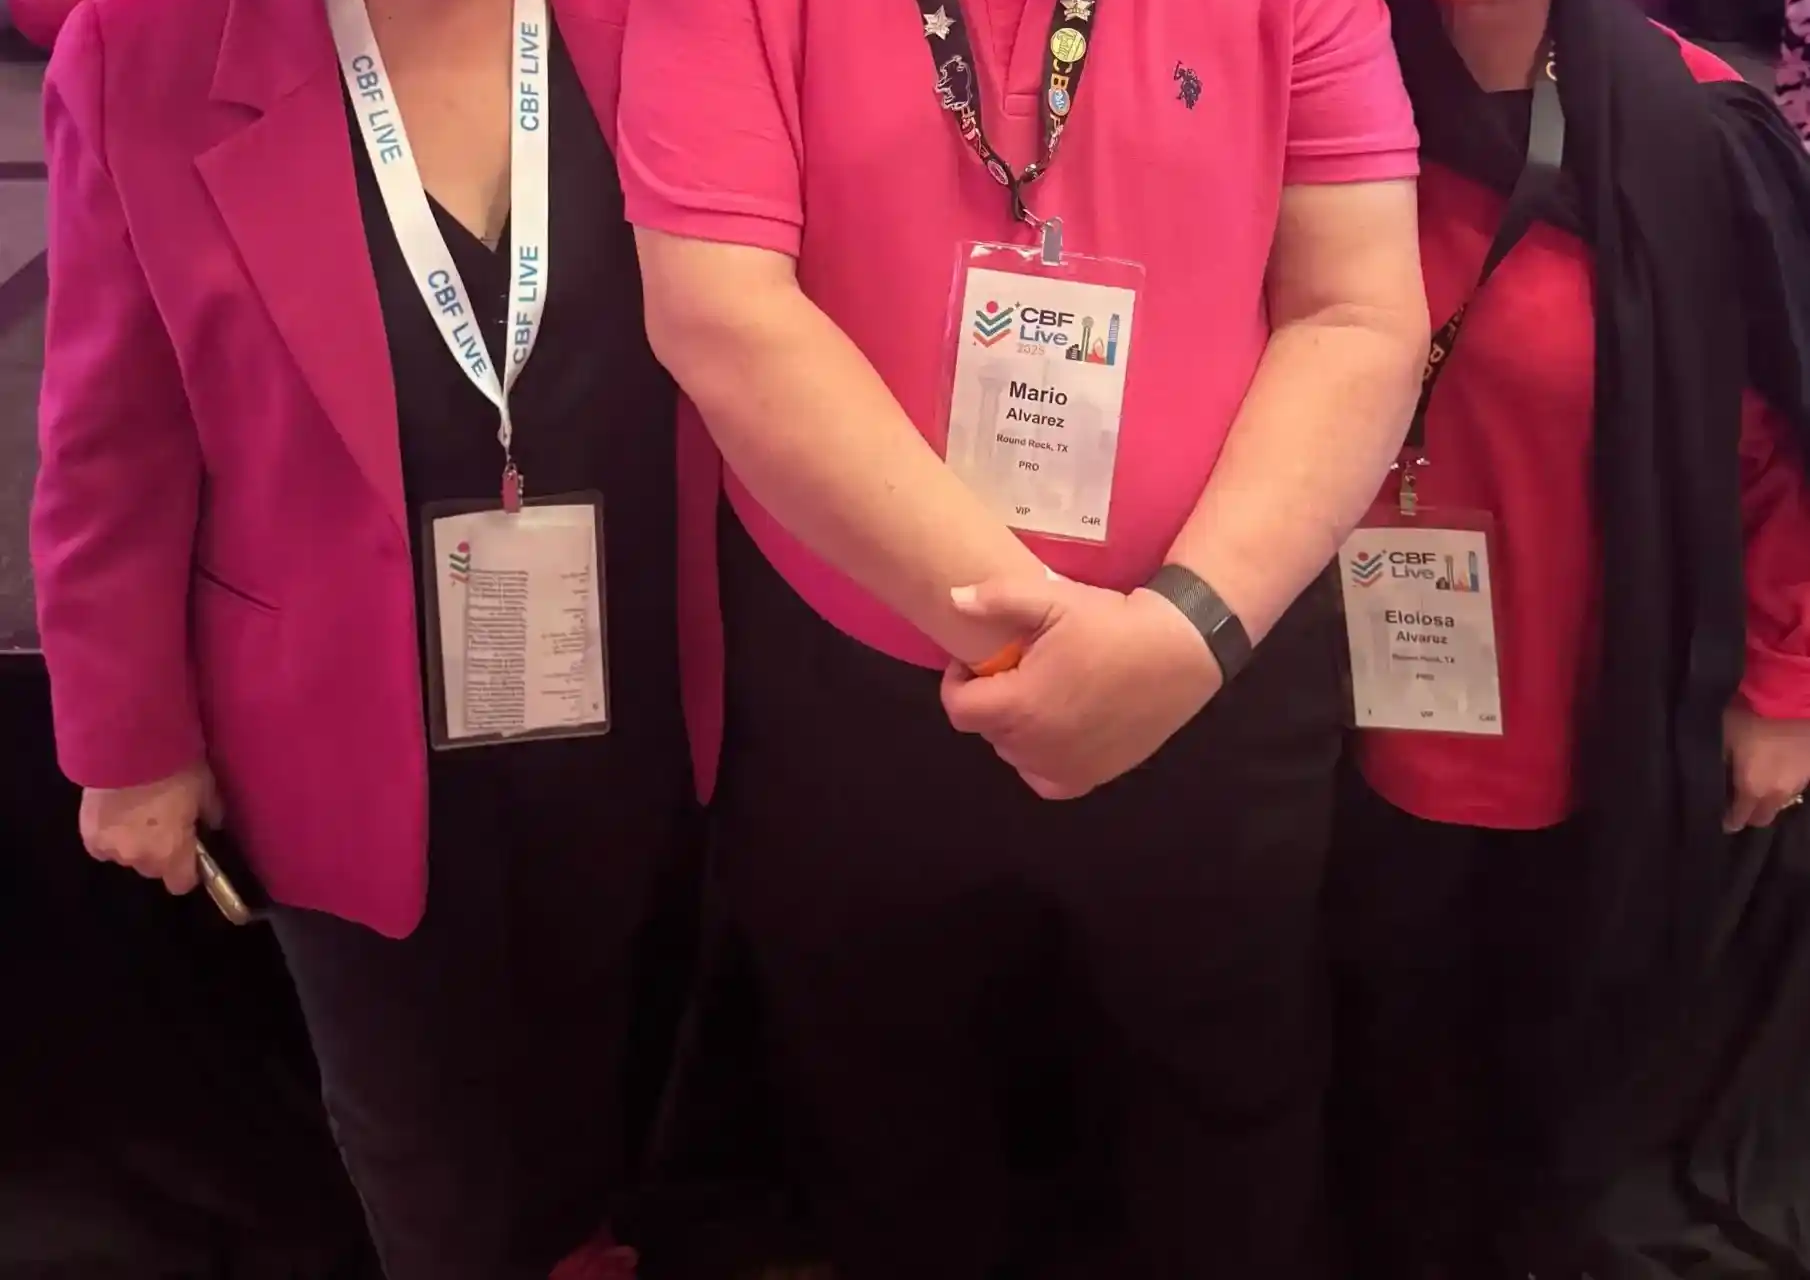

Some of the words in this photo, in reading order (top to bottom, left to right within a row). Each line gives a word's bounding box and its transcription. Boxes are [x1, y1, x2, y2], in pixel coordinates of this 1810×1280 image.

[520, 21, 540, 75] LIVE
[352, 55, 384, 102] CBF
[368, 109, 403, 164] LIVE
[520, 81, 540, 132] CBF
[518, 245, 538, 302] LIVE
[427, 269, 464, 317] CBF
[452, 322, 488, 378] LIVE
[1020, 307, 1075, 328] CBF
[513, 312, 534, 364] CBF
[1020, 324, 1068, 346] Live
[1009, 380, 1068, 405] Mario
[1006, 407, 1065, 428] Alvarez
[996, 433, 1027, 446] Round
[1057, 443, 1068, 453] TX
[1018, 460, 1039, 471] PRO
[1015, 506, 1031, 515] VIP
[1389, 551, 1436, 564] CBF
[1391, 564, 1435, 579] Live
